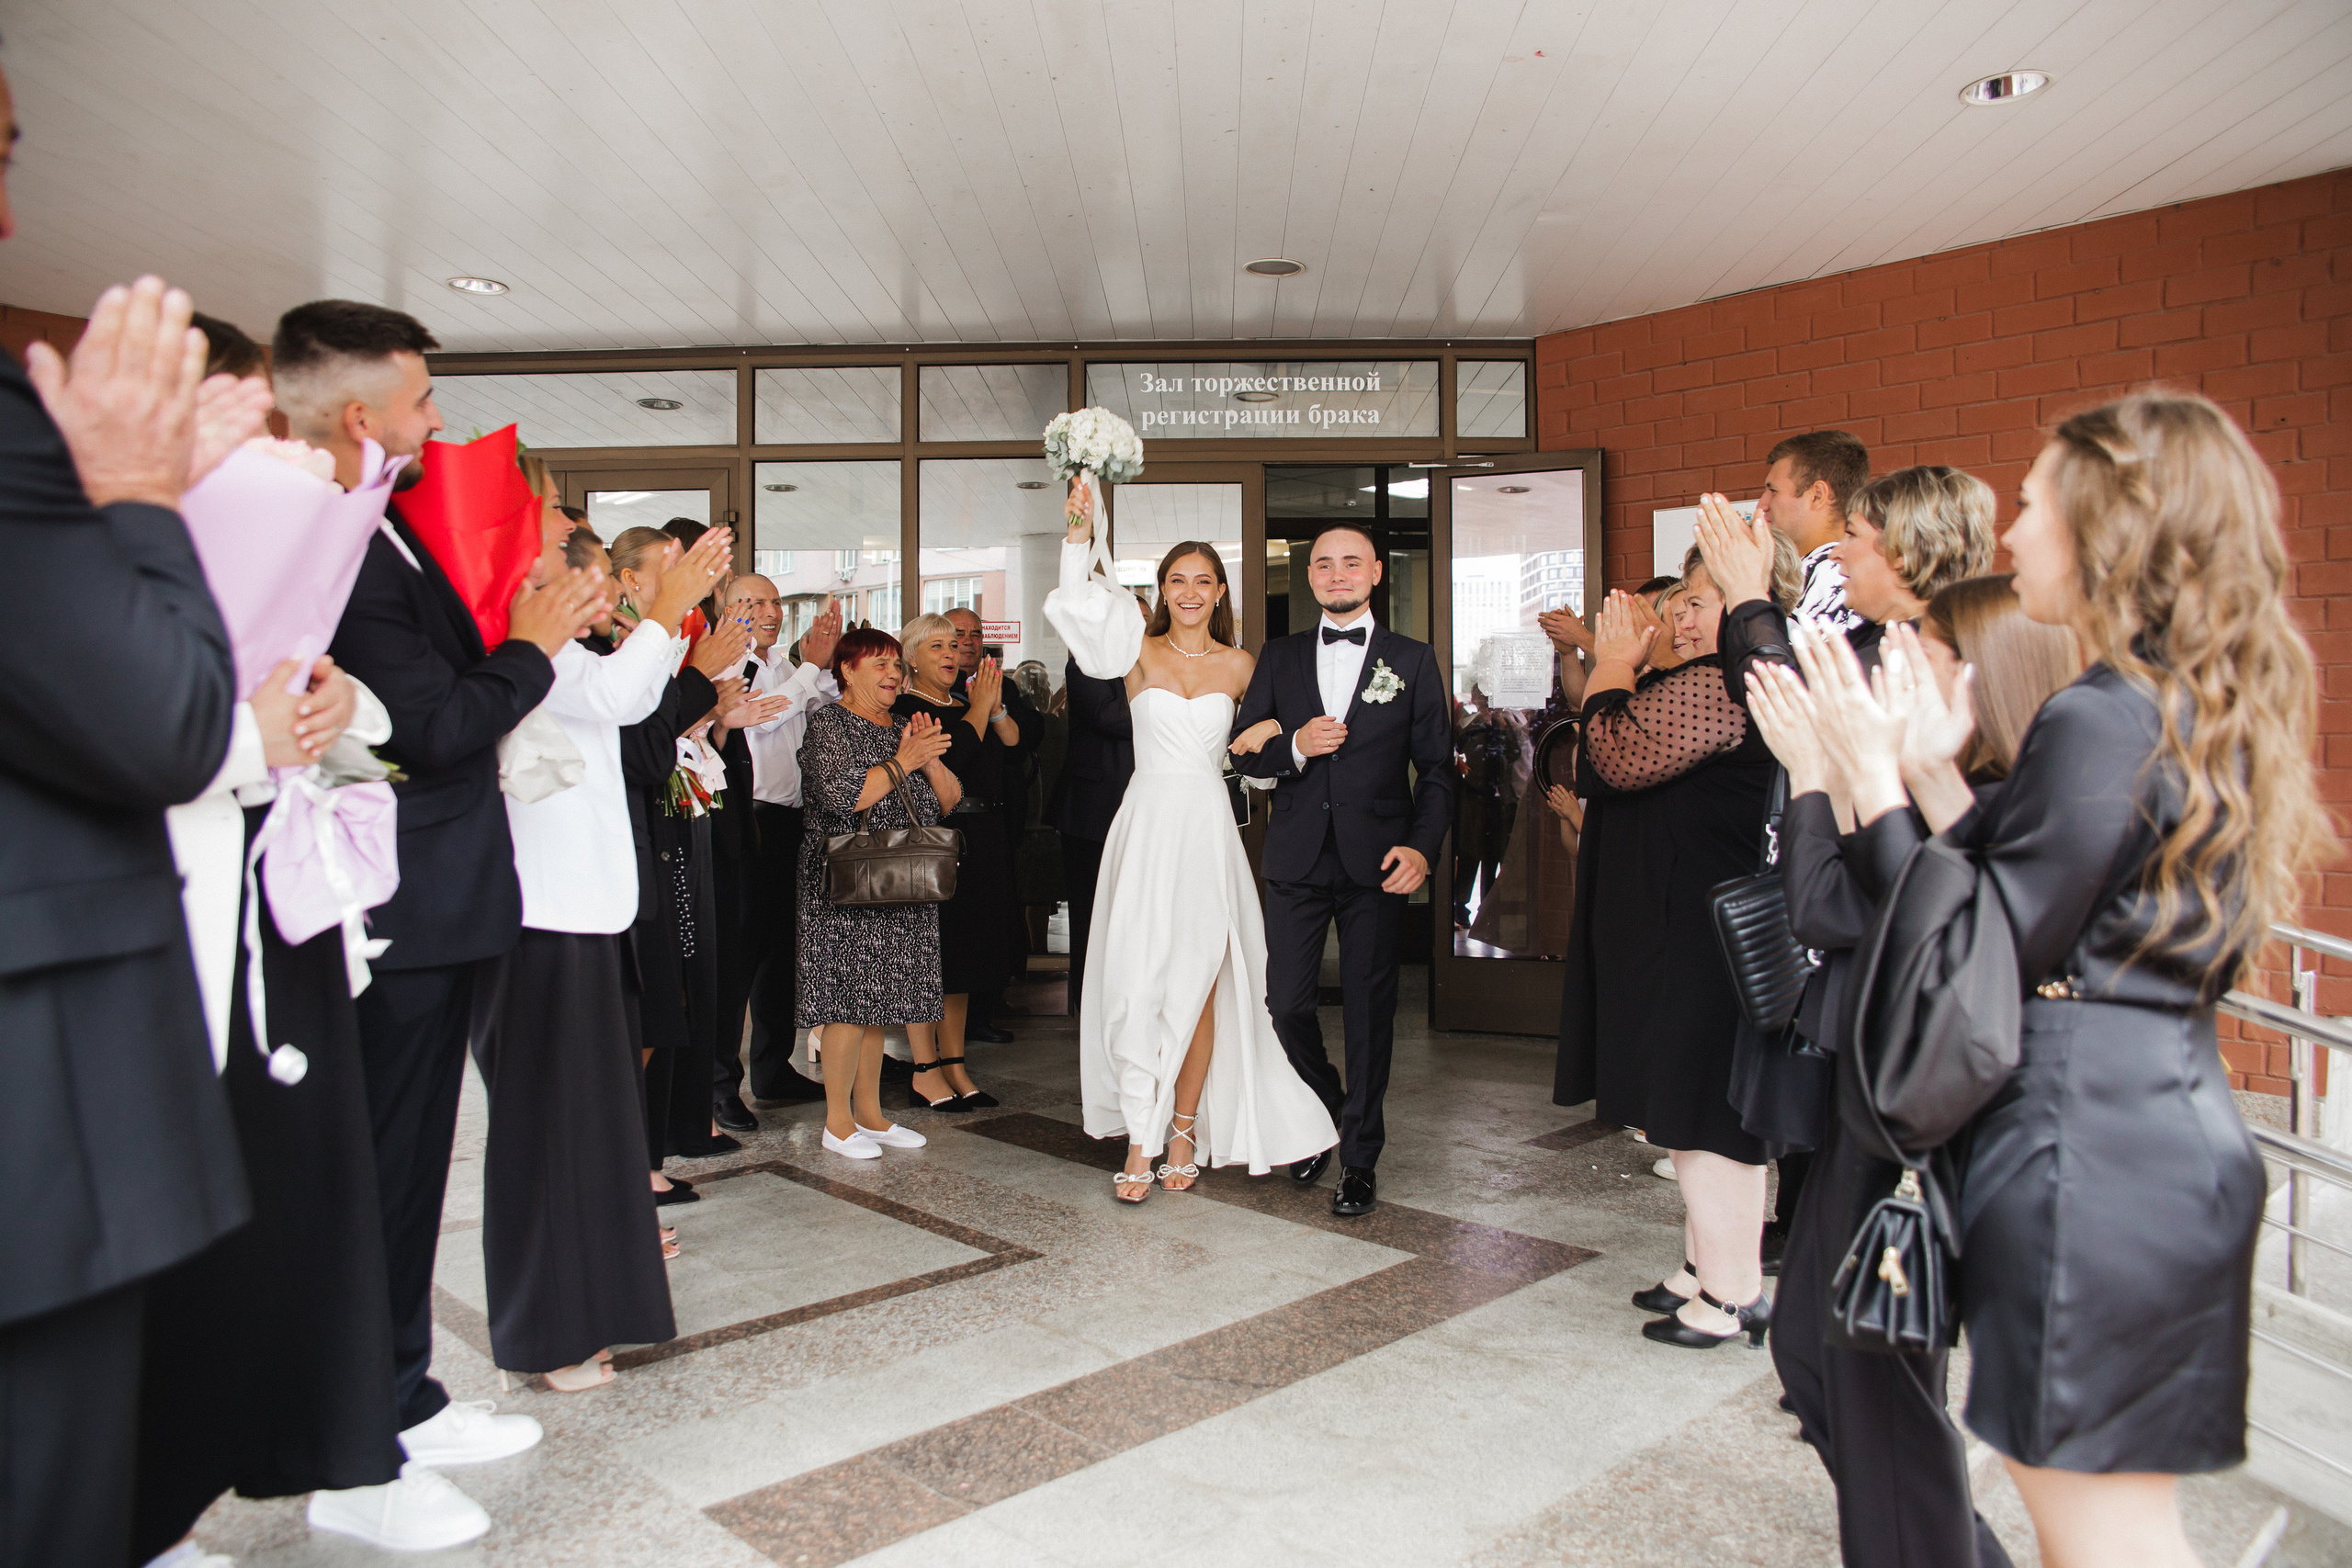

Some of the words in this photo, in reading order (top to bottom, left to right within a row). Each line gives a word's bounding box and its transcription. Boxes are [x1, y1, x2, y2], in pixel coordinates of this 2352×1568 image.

[1139, 372, 1183, 393] Зал
[1191, 371, 1381, 398] торжественной
[1141, 409, 1300, 431] регистрации
[1308, 403, 1380, 429] брака
